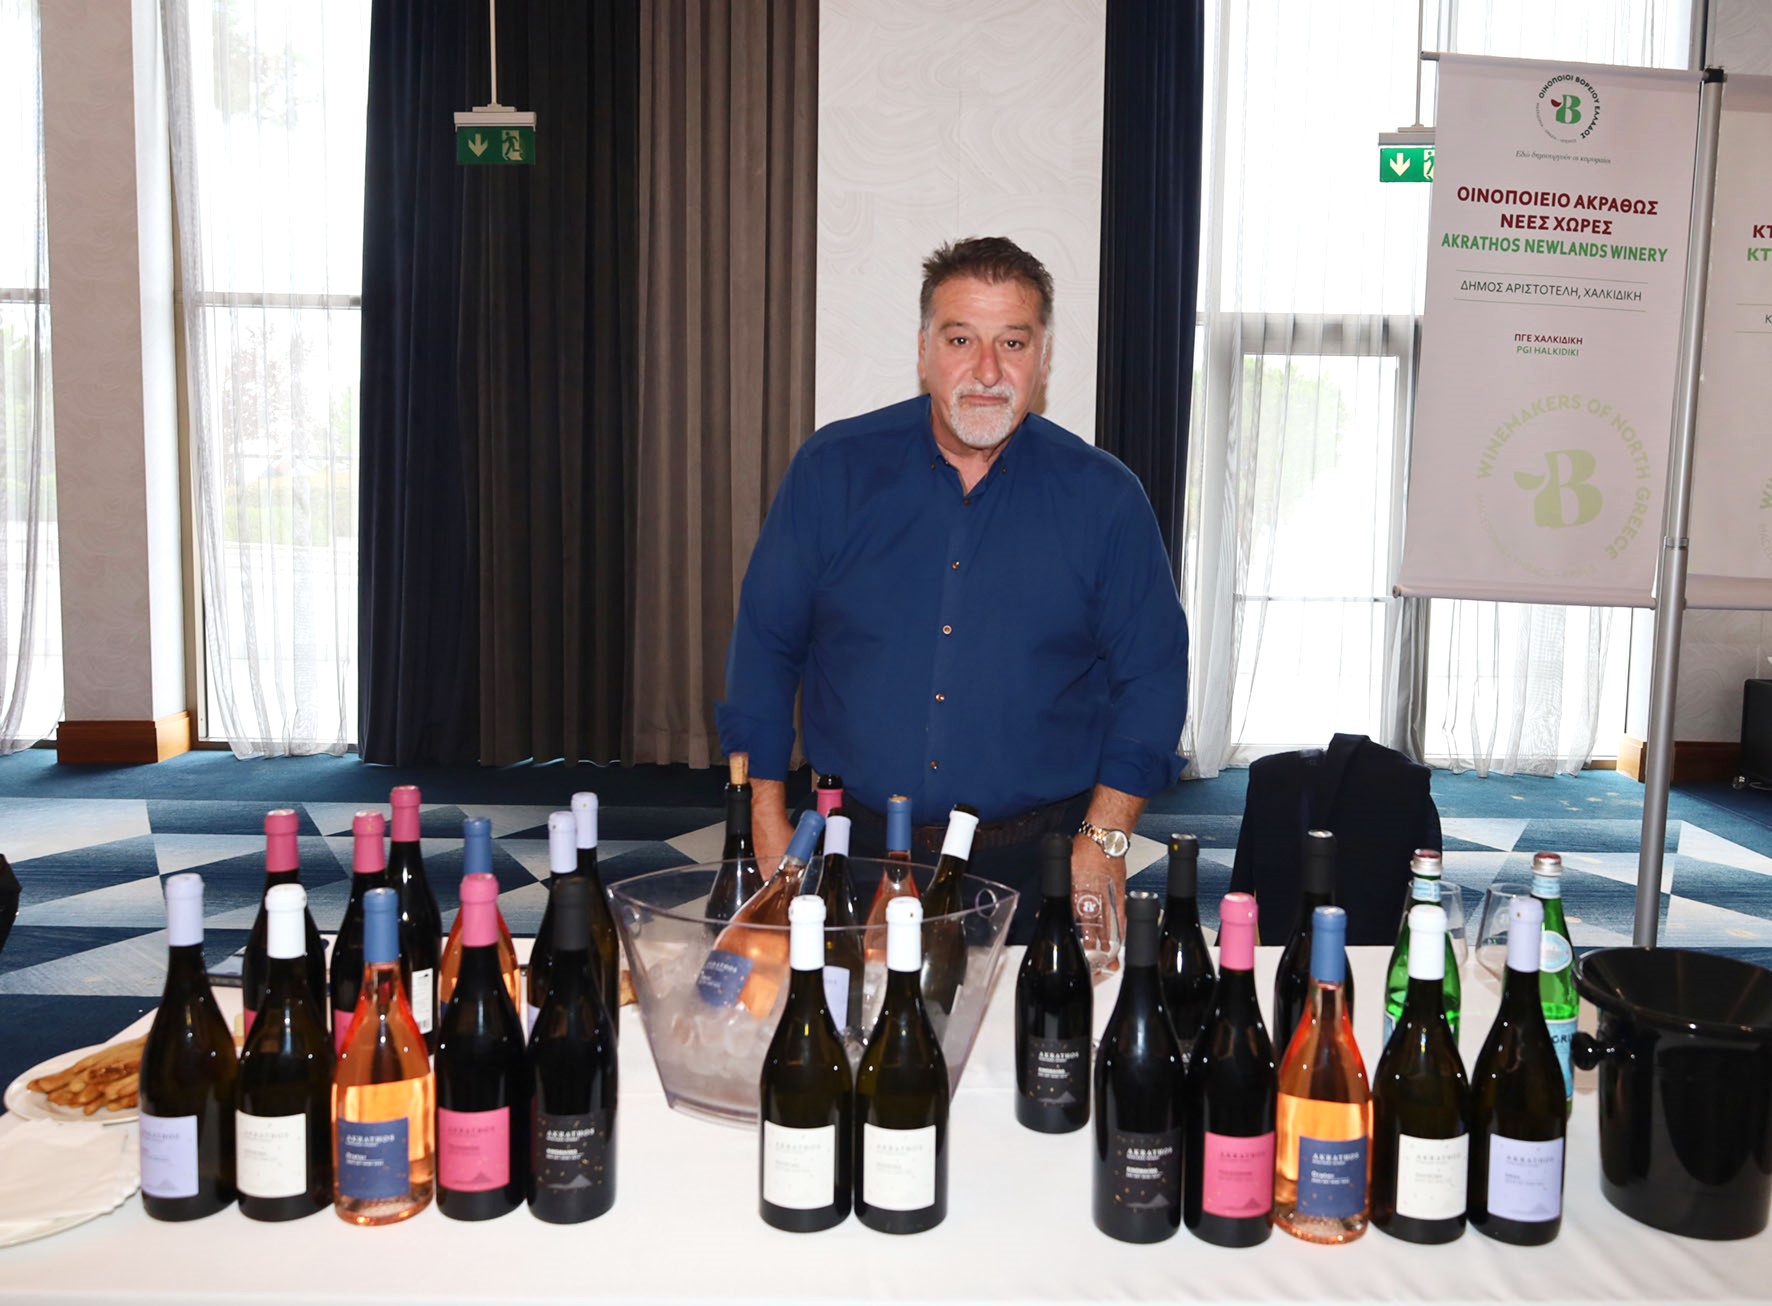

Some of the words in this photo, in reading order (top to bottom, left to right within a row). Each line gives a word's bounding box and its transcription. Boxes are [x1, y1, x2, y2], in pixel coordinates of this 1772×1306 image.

[1538, 74, 1574, 99] ΟΙΝΟΠΟΙΟΙ
[1575, 76, 1600, 104] ΒΟΡΕΙΟΥ
[1457, 186, 1571, 208] ΟΙΝΟΠΟΙΕΙΟ
[1573, 194, 1659, 216] ΑΚΡΑΘΩΣ
[1500, 213, 1550, 231] ΝΕΕΣ
[1553, 216, 1613, 236] ΧΩΡΕΣ
[1441, 232, 1521, 253] AKRATHOS
[1524, 238, 1608, 259] NEWLANDS
[1610, 244, 1668, 263] WINERY
[1460, 279, 1504, 293] ΔΗΜΟΣ
[1505, 283, 1582, 300] ΑΡΙΣΤΟΤΕΛΗ,
[1583, 287, 1642, 302] ΧΑΛΚΙΔΙΚΗ
[1514, 333, 1532, 343] ΠΓΕ
[1533, 334, 1583, 345] ΧΑΛΚΙΔΙΚΗ
[1516, 345, 1532, 355] PGI
[1534, 346, 1579, 357] HALKIDIKI
[1586, 397, 1613, 419] OF
[1476, 394, 1582, 480] WINEMAKERS
[1610, 413, 1651, 480] NORTH
[1603, 486, 1651, 561] GREECE
